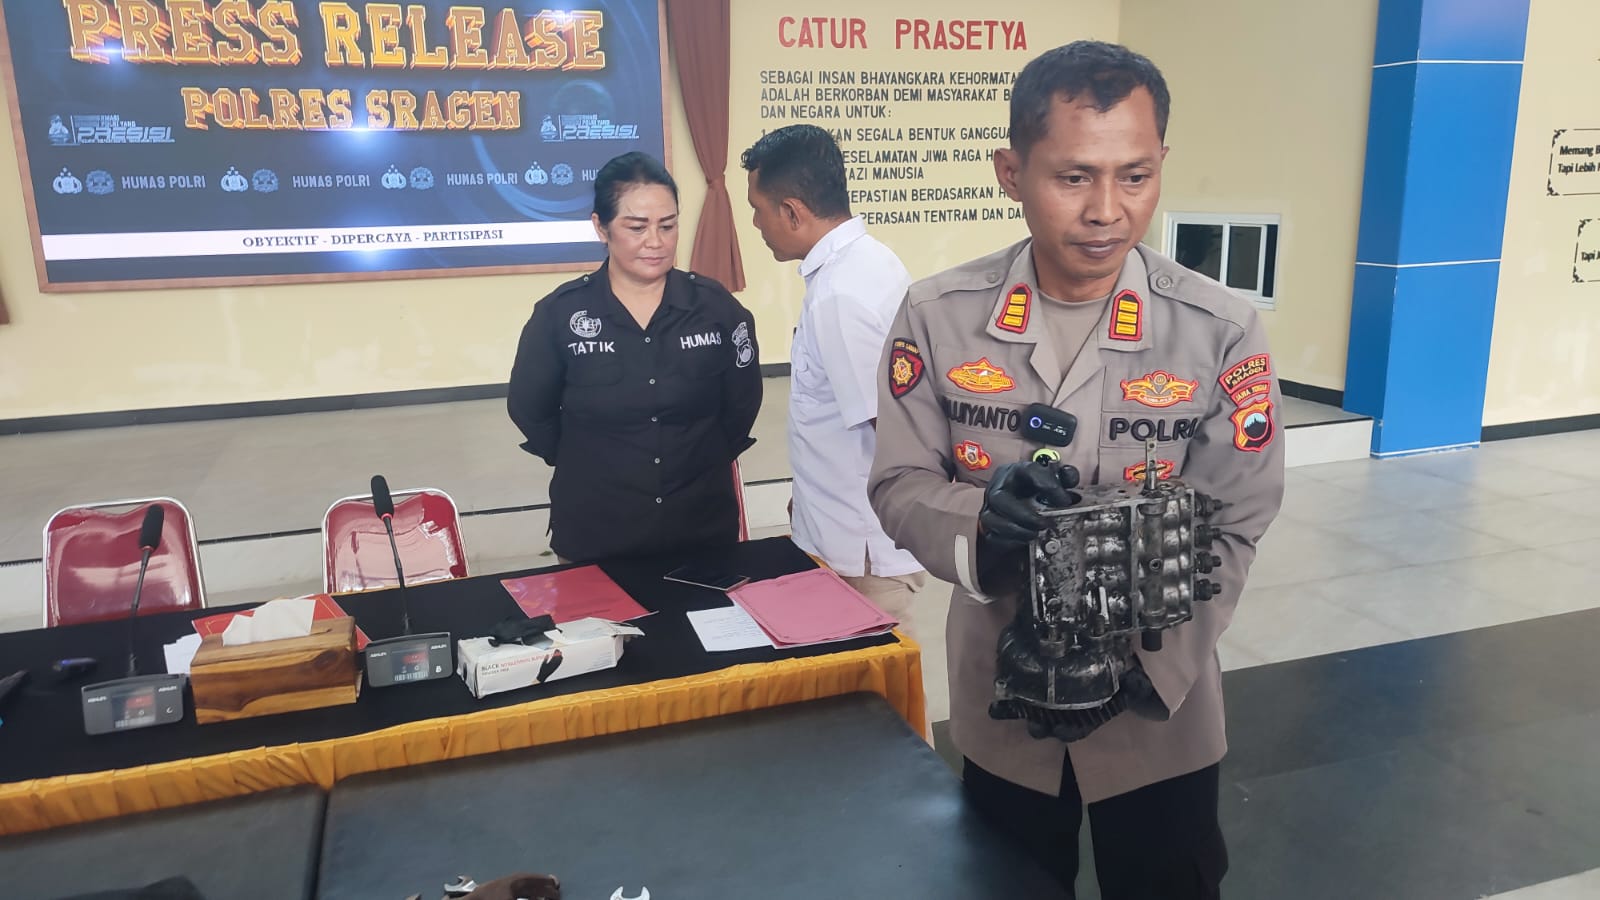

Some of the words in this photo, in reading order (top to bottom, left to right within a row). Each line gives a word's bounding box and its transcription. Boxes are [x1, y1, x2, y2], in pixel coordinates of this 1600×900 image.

[64, 0, 303, 66] PRESS
[319, 2, 607, 72] RELEASE
[778, 16, 867, 49] CATUR
[895, 18, 1027, 50] PRASETYA
[760, 70, 813, 84] SEBAGAI
[819, 71, 855, 84] INSAN
[861, 71, 945, 85] BHAYANGKARA
[950, 72, 1020, 85] KEHORMATA
[761, 87, 810, 101] ADALAH
[816, 88, 889, 101] BERKORBAN
[894, 88, 922, 101] DEMI
[927, 88, 998, 101] MASYARAKAT
[1004, 88, 1012, 101] B
[181, 87, 353, 130] POLRES
[366, 90, 521, 131] SRAGEN
[761, 105, 786, 119] DAN
[791, 105, 841, 119] NEGARA
[857, 128, 903, 141] SEGALA
[909, 128, 956, 141] BENTUK
[842, 150, 918, 163] ESELAMATAN
[922, 150, 948, 163] JIWA
[953, 149, 982, 162] RAGA
[986, 149, 994, 162] H
[1560, 145, 1594, 157] Memang
[582, 169, 600, 182] HU
[845, 168, 868, 181] AZI
[873, 167, 925, 180] MANUSIA
[1558, 162, 1574, 176] Tapi
[1575, 161, 1596, 173] Lebih
[122, 176, 166, 190] HUMAS
[169, 174, 206, 189] POLRI
[292, 175, 333, 188] HUMAS
[336, 174, 370, 188] POLRI
[446, 173, 484, 186] HUMAS
[487, 172, 518, 185] POLRI
[911, 187, 994, 201] BERDASARKAN
[924, 209, 978, 223] TENTRAM
[982, 208, 1003, 221] DAN
[242, 236, 319, 248] OBYEKTIF
[331, 232, 412, 246] DIPERCAYA
[424, 229, 504, 242] PARTISIPASI
[680, 331, 722, 349] HUMAS
[567, 341, 616, 356] TATIK
[1225, 358, 1265, 385] POLRES
[1109, 417, 1199, 442] POLRI
